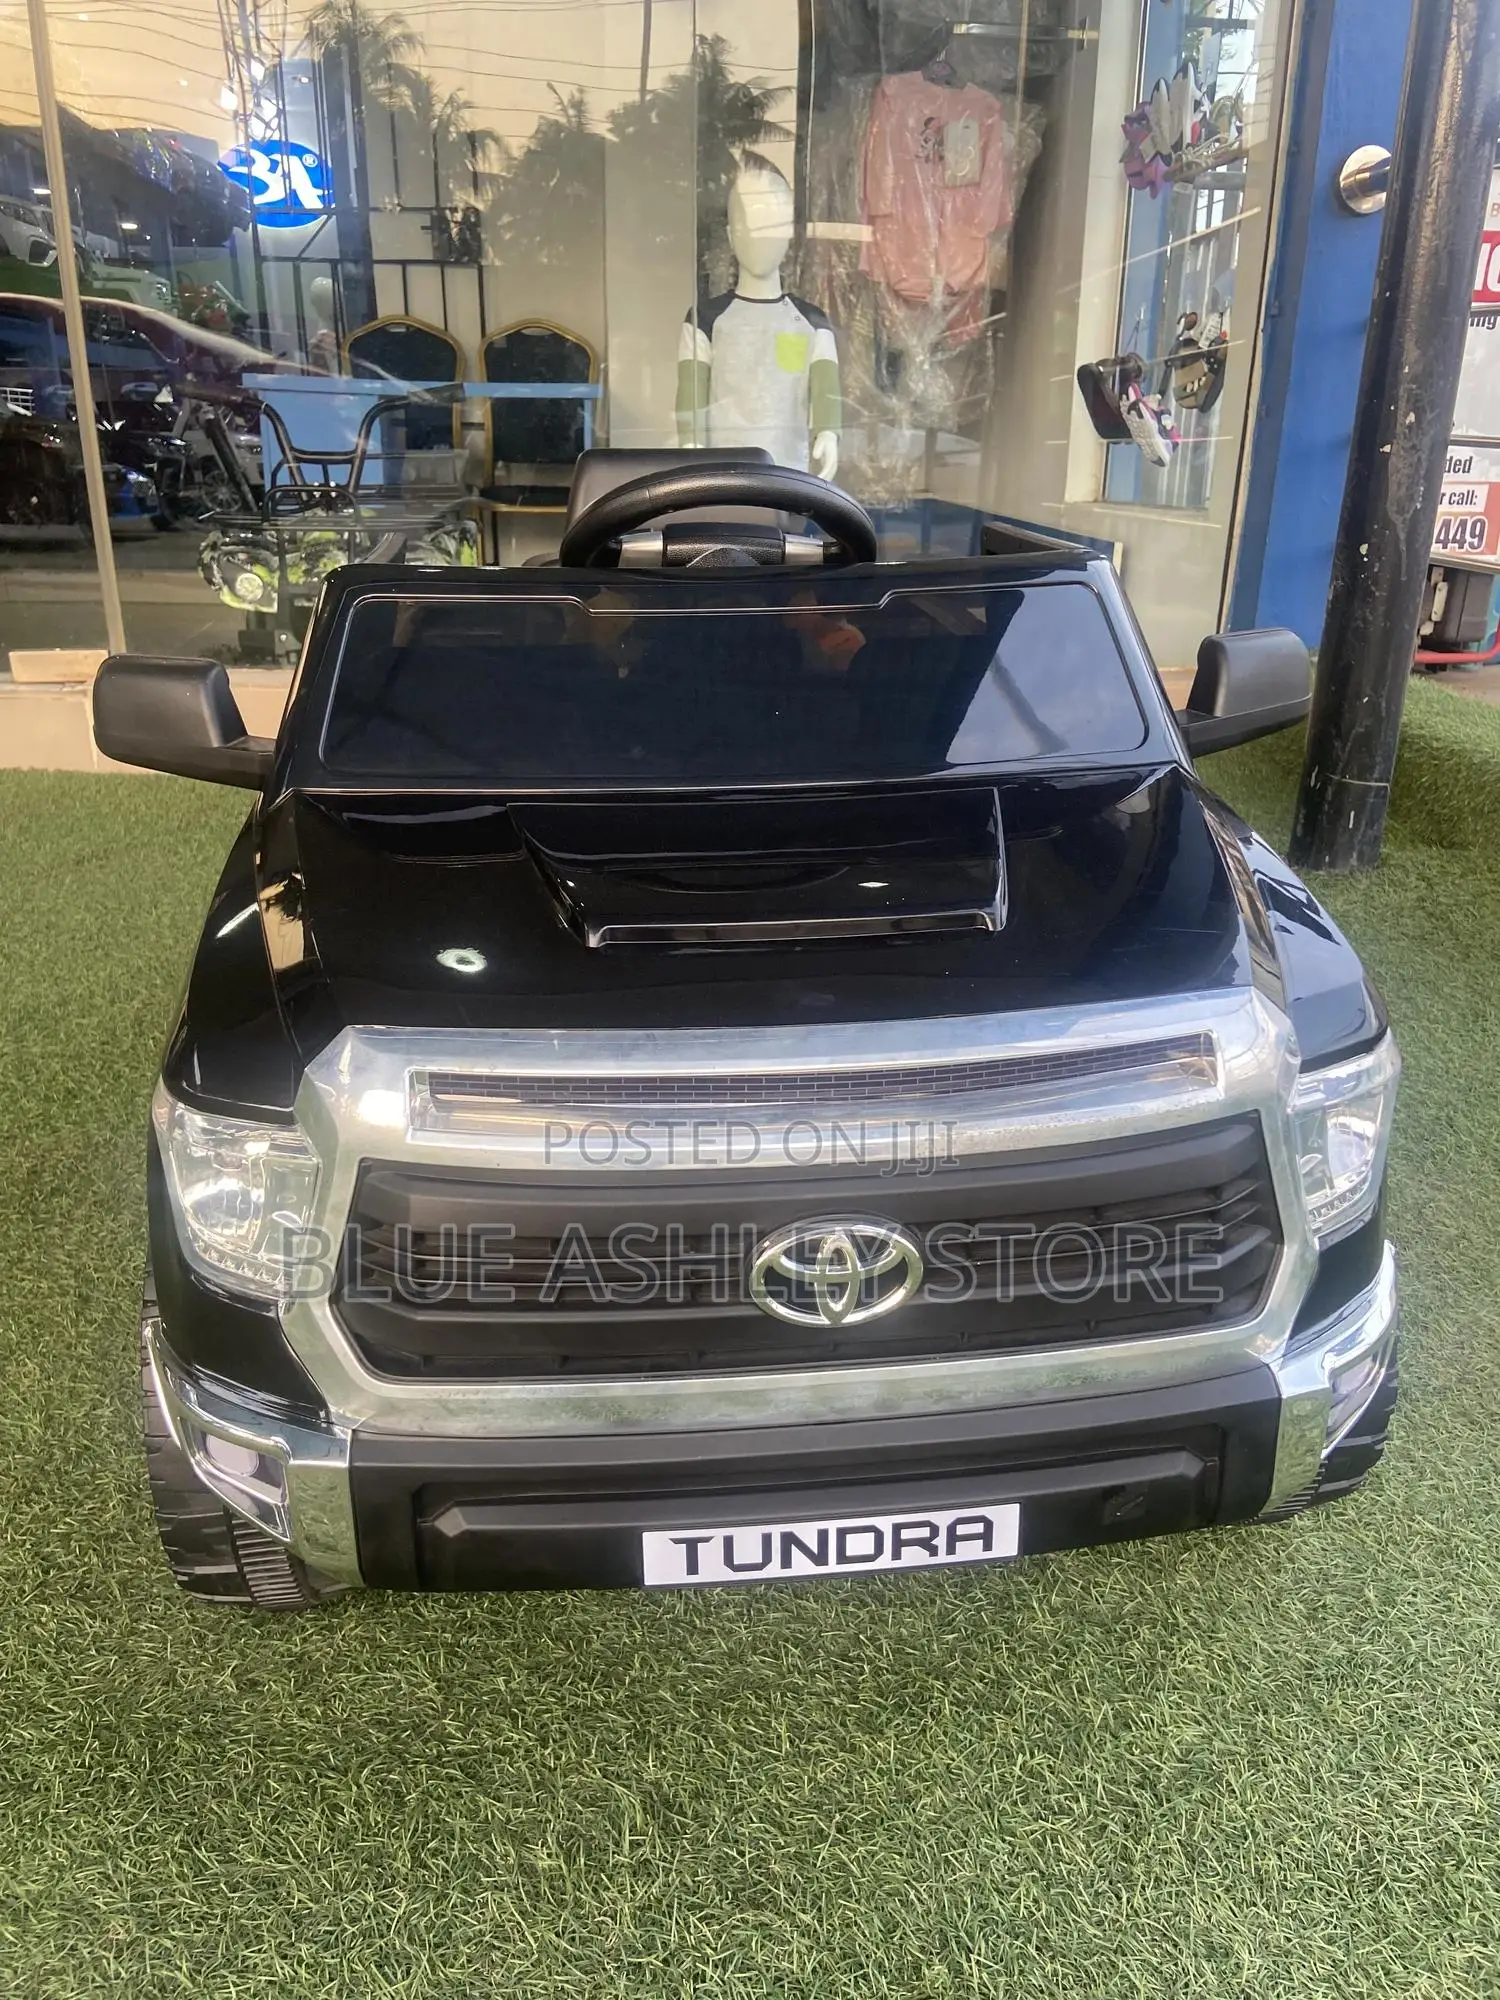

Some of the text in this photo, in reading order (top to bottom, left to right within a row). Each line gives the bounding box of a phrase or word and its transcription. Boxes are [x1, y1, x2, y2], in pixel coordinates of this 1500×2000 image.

[1448, 489, 1478, 505] call:
[1434, 517, 1487, 551] 449
[668, 1514, 994, 1576] TUNDRA
